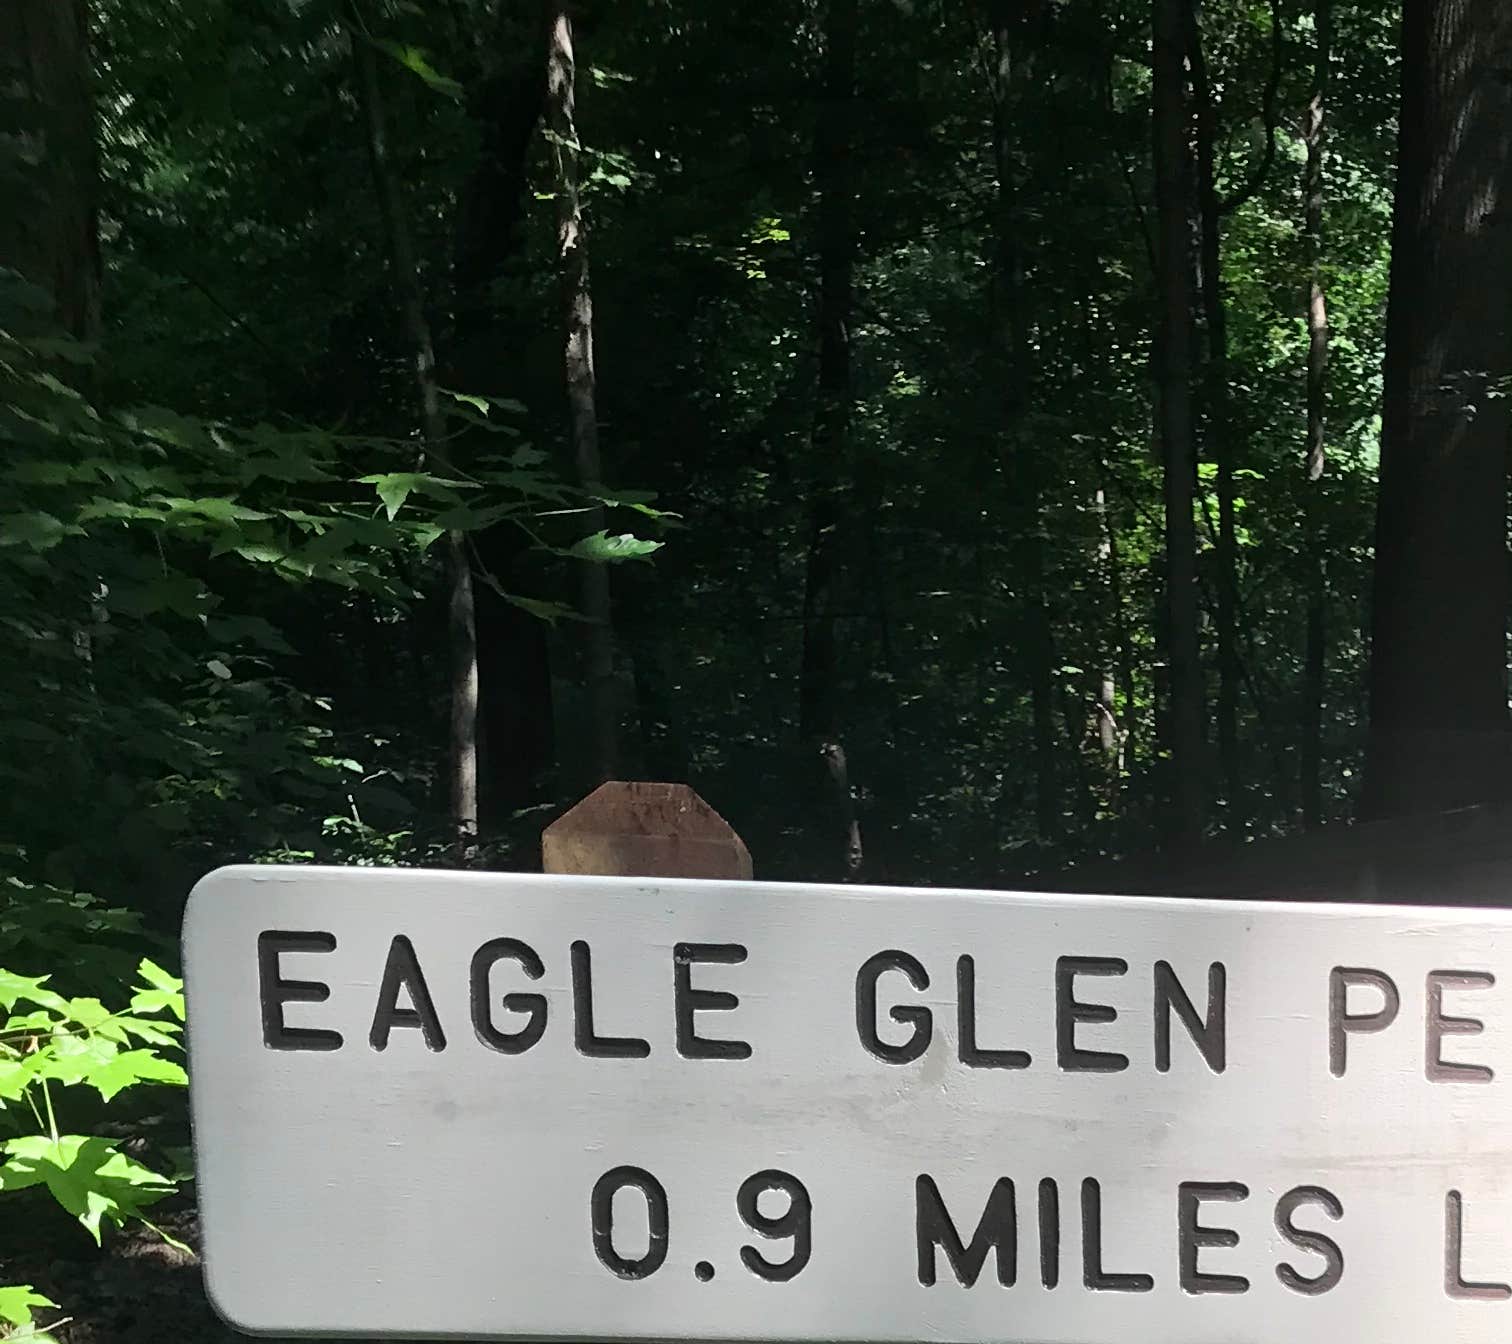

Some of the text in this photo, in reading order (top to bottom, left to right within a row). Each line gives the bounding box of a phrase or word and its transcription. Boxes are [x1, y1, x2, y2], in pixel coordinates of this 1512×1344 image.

[257, 930, 753, 1060] EAGLE
[854, 949, 1228, 1075] GLEN
[590, 1164, 812, 1282] 0.9
[915, 1173, 1346, 1297] MILES
